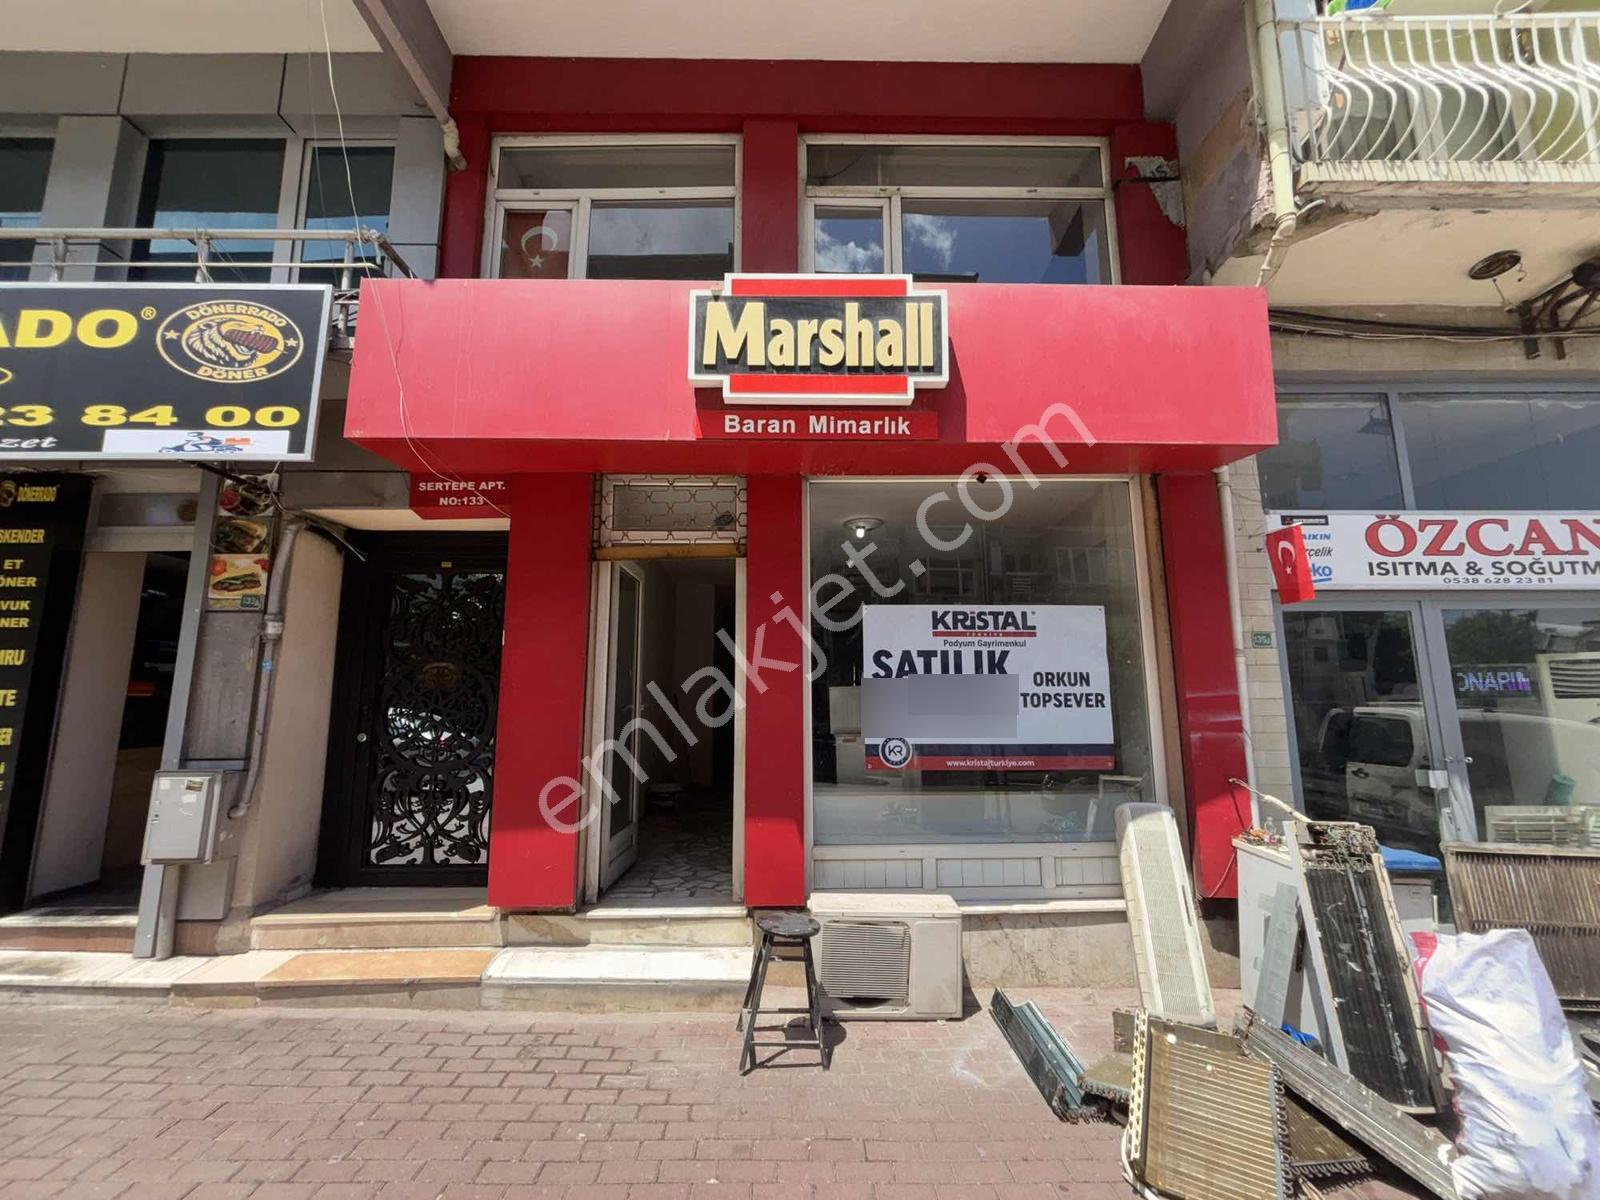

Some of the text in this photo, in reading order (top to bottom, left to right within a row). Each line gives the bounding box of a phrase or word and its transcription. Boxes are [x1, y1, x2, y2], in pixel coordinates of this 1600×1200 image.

[186, 304, 287, 327] DÖNERRADO
[0, 309, 138, 348] DO
[703, 301, 934, 369] Marshall
[197, 366, 268, 379] DÖNER
[0, 405, 300, 427] 3 84 00
[724, 415, 911, 435] Baran Mimarlık
[418, 481, 506, 491] SERTEPE APT.
[440, 497, 484, 506] NO:133
[1365, 514, 1600, 557] ÖZCAN
[1306, 546, 1333, 559] çelik
[3, 559, 24, 570] ET
[1311, 563, 1333, 577] ko
[1368, 561, 1458, 576] ISITMA
[1465, 561, 1484, 576] &
[943, 640, 1026, 649] Podyum Gayrimenkul
[1033, 671, 1091, 687] ORKUN
[1020, 692, 1106, 709] TOPSEVER
